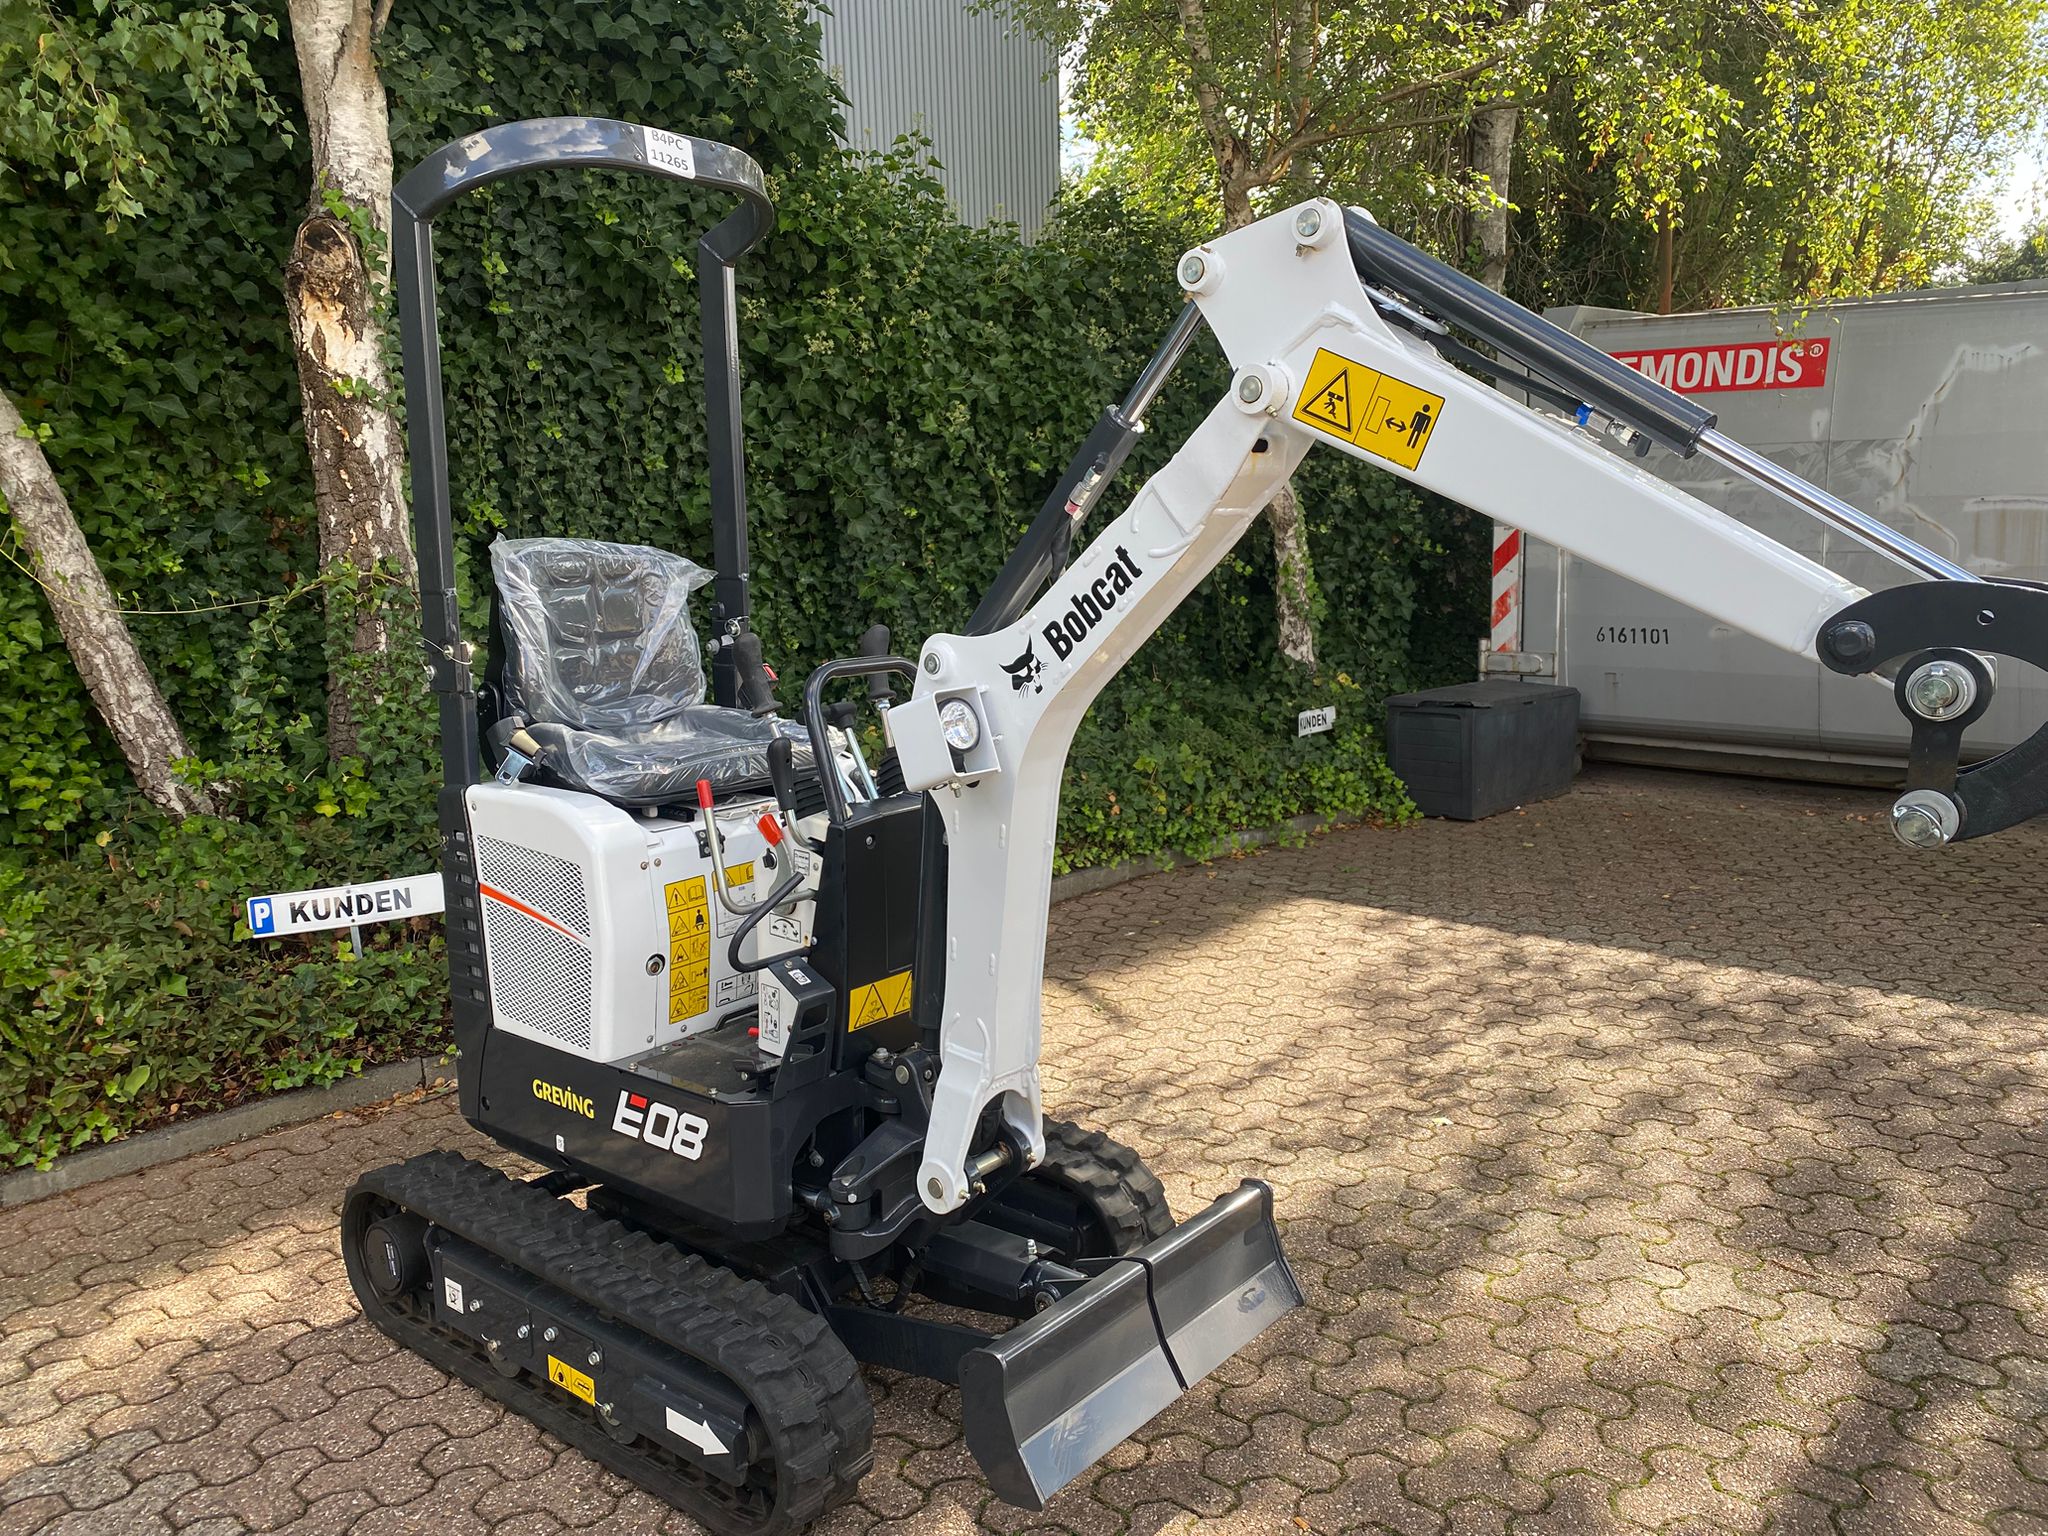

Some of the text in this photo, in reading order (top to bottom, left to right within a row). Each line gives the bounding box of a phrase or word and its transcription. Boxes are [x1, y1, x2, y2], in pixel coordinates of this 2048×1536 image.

[651, 149, 689, 171] 11265
[1041, 544, 1143, 662] Bobcat
[1596, 626, 1669, 645] 6161101
[254, 886, 413, 929] P KUNDEN
[611, 1089, 710, 1161] E08
